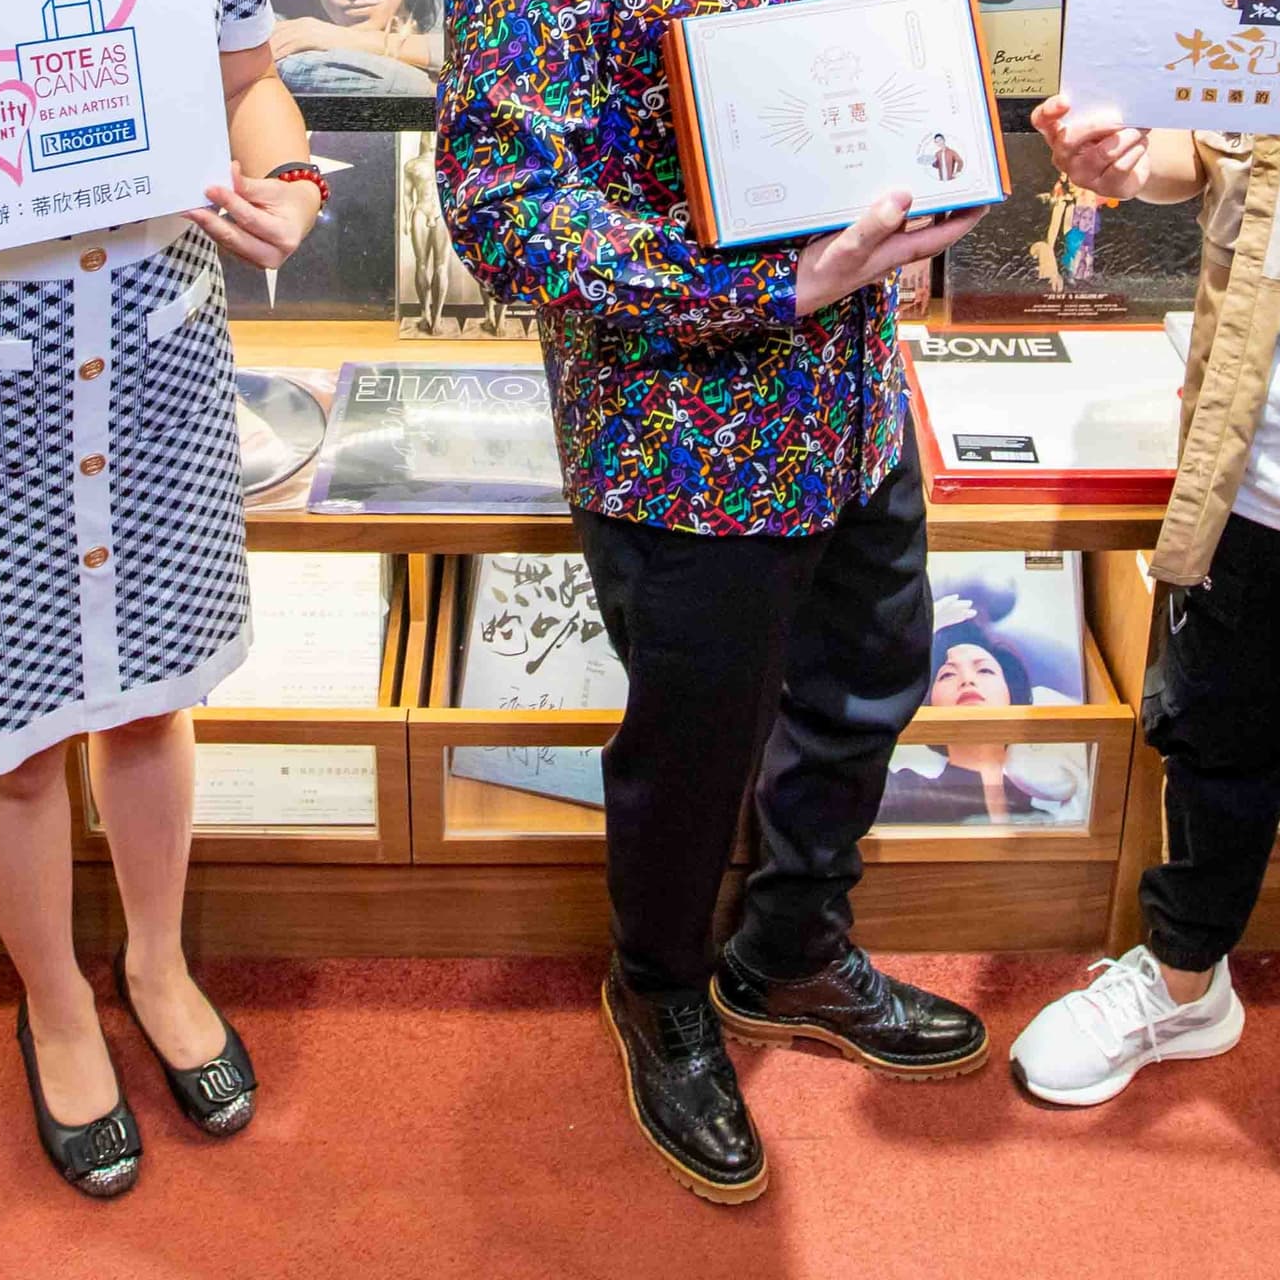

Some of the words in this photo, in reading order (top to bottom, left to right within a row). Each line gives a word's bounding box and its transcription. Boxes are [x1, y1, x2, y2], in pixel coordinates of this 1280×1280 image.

[30, 47, 94, 75] TOTE
[100, 44, 127, 65] AS
[993, 49, 1043, 65] Bowie
[33, 64, 130, 99] CANVAS
[39, 108, 56, 122] BE
[59, 104, 78, 118] AN
[82, 95, 131, 115] ARTIST!
[62, 127, 131, 151] ROOTOTE
[920, 337, 1057, 357] BOWIE
